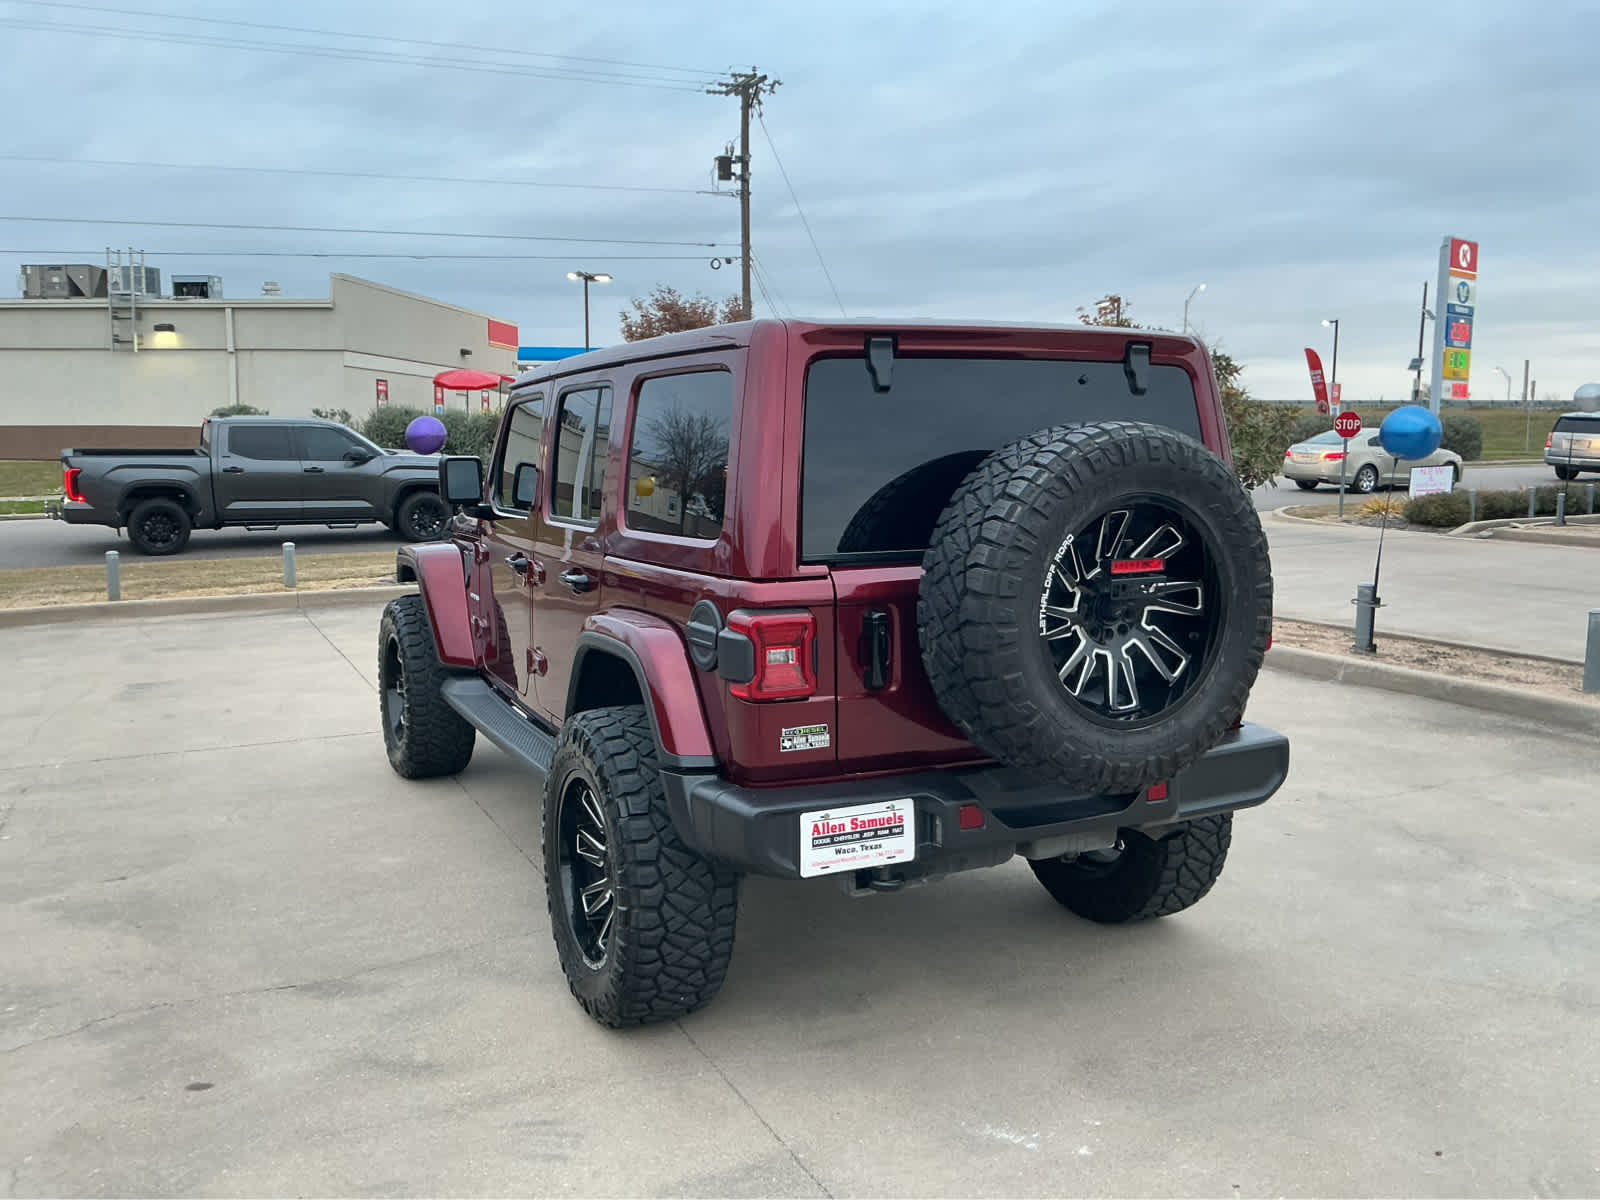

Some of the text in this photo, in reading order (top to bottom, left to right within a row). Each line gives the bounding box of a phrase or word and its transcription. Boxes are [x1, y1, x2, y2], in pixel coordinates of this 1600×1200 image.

[1335, 419, 1360, 430] STOP
[1040, 589, 1050, 636] LETHAL
[1054, 534, 1074, 562] ROAD
[812, 812, 904, 836] Allen Samuels
[833, 833, 860, 842] CHRYSLER
[834, 843, 882, 856] Waco, Texas
